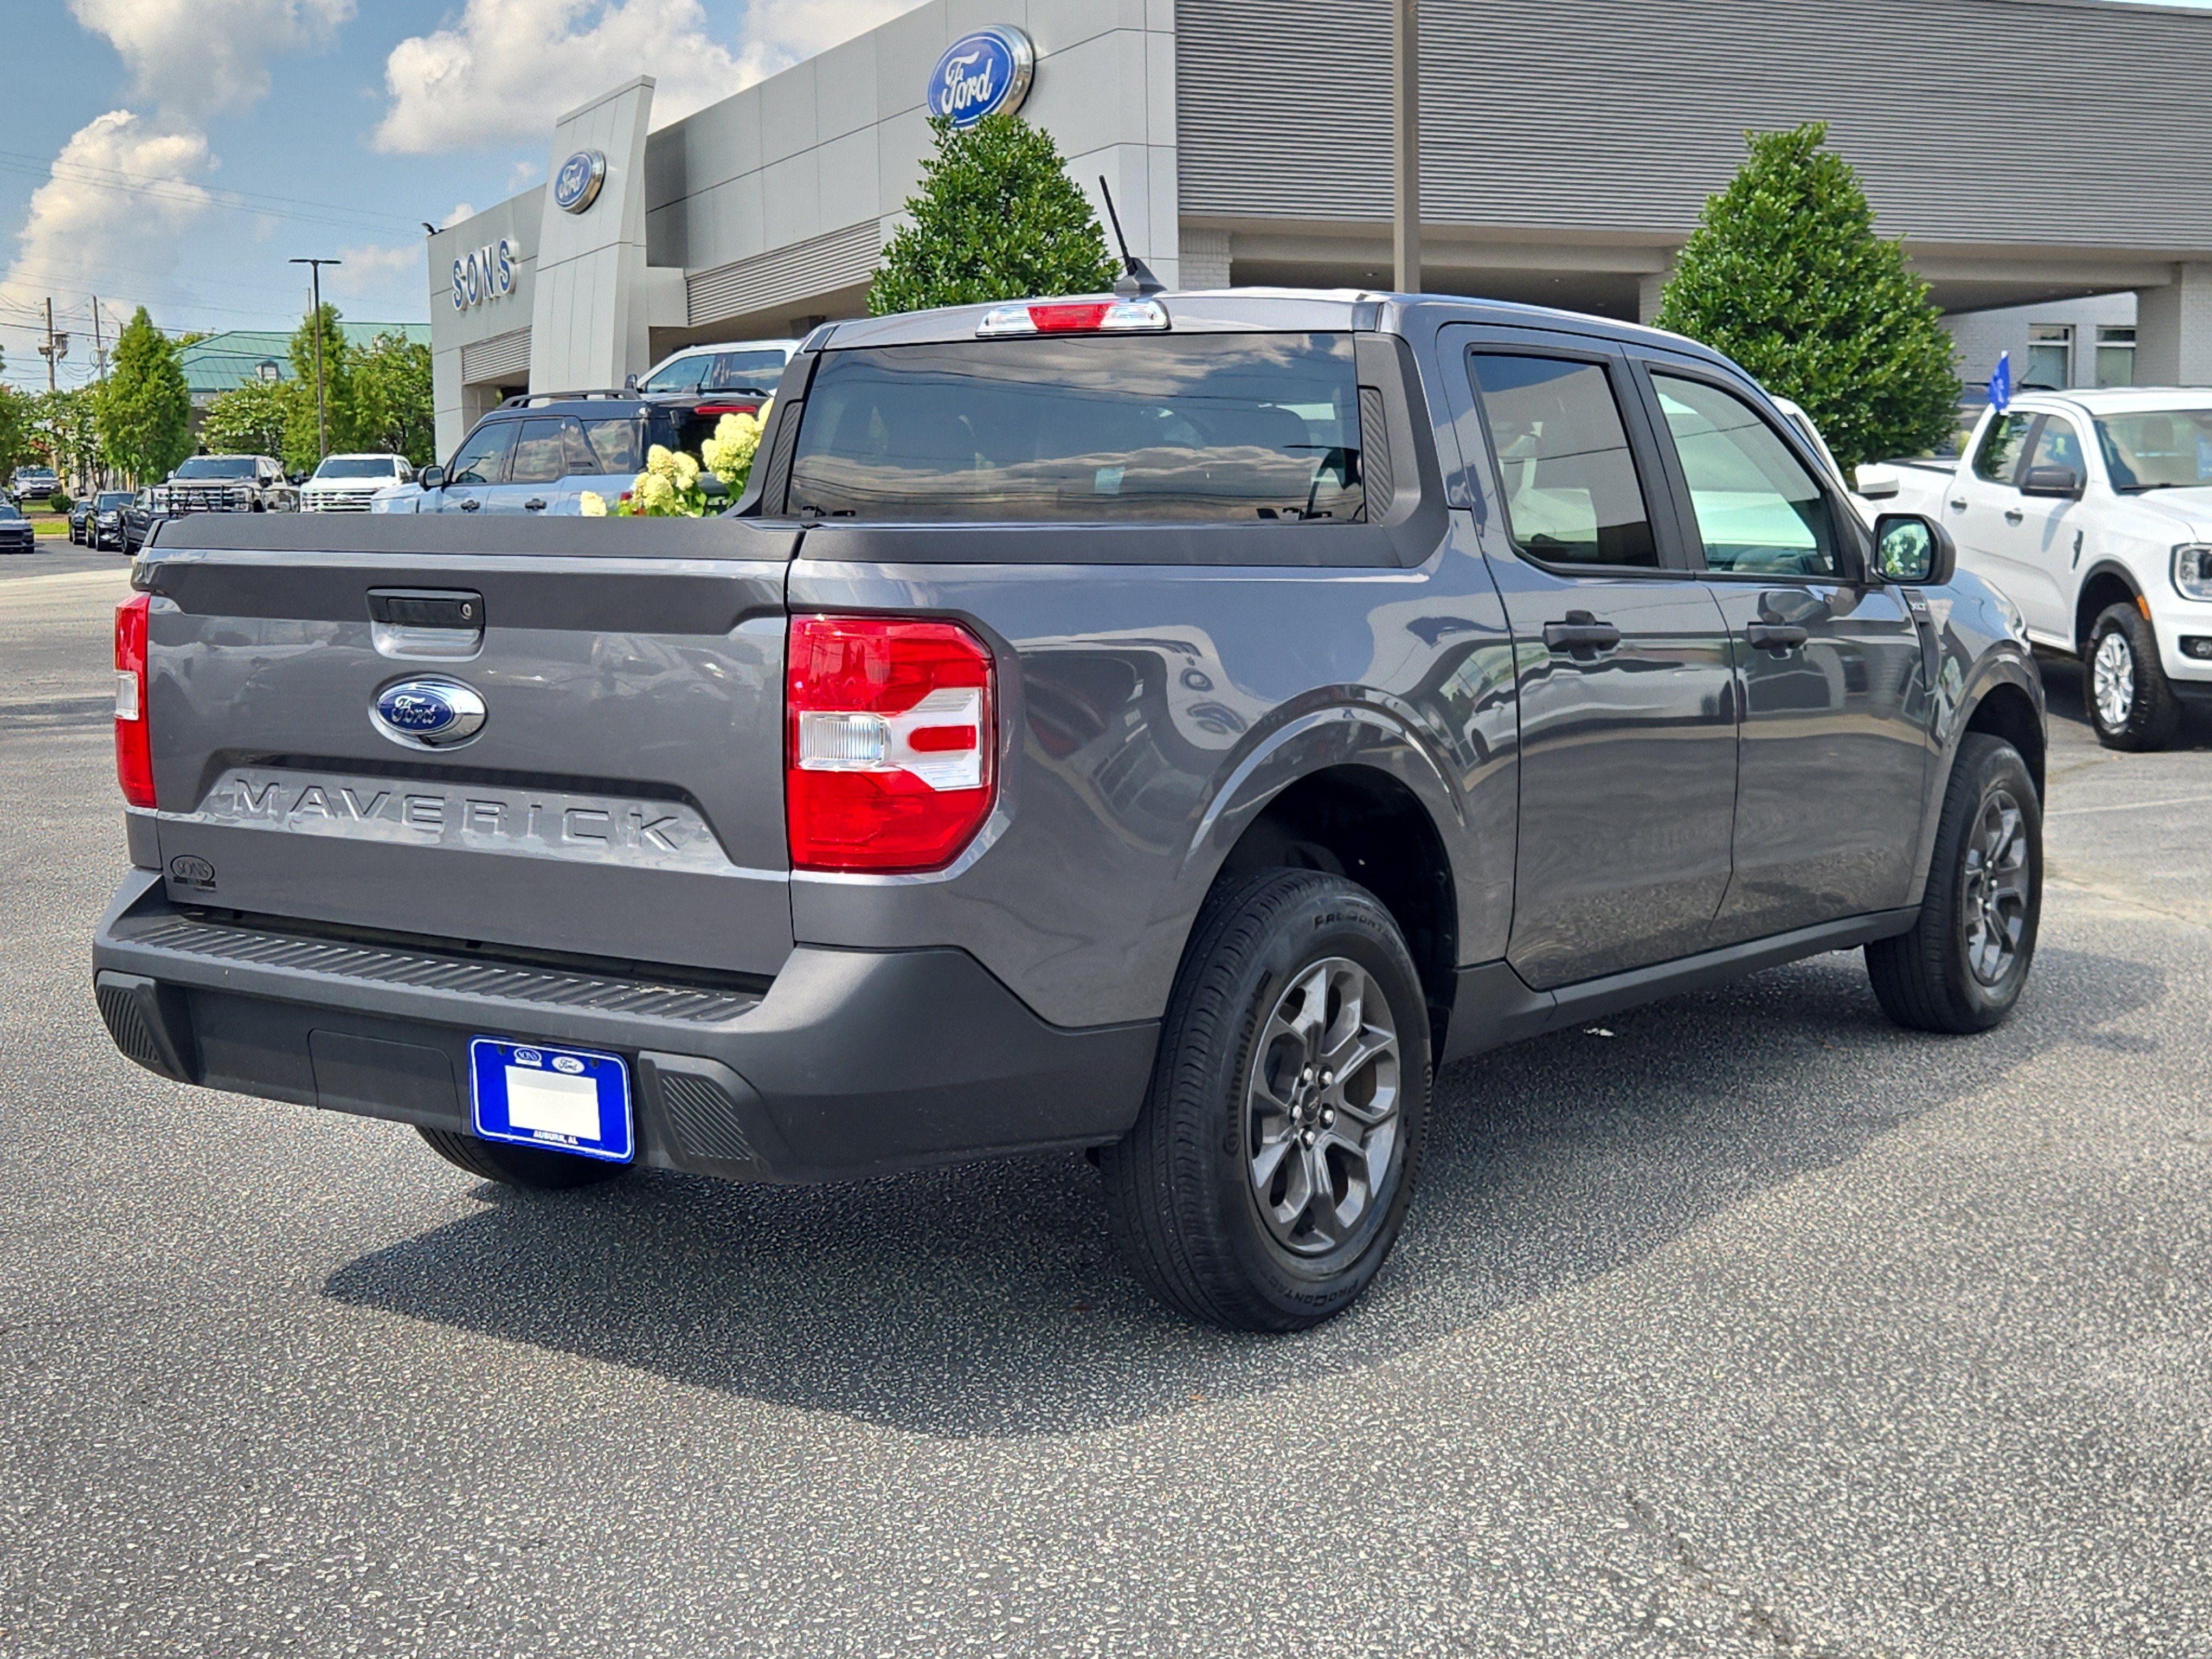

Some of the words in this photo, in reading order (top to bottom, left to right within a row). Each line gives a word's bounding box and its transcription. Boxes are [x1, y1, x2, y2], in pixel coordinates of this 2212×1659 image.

[941, 51, 993, 114] Ford
[558, 162, 584, 199] Ford
[452, 237, 517, 311] SONS
[391, 695, 438, 724] Ford
[233, 778, 680, 852] MAVERICK
[558, 1058, 577, 1071] Ford
